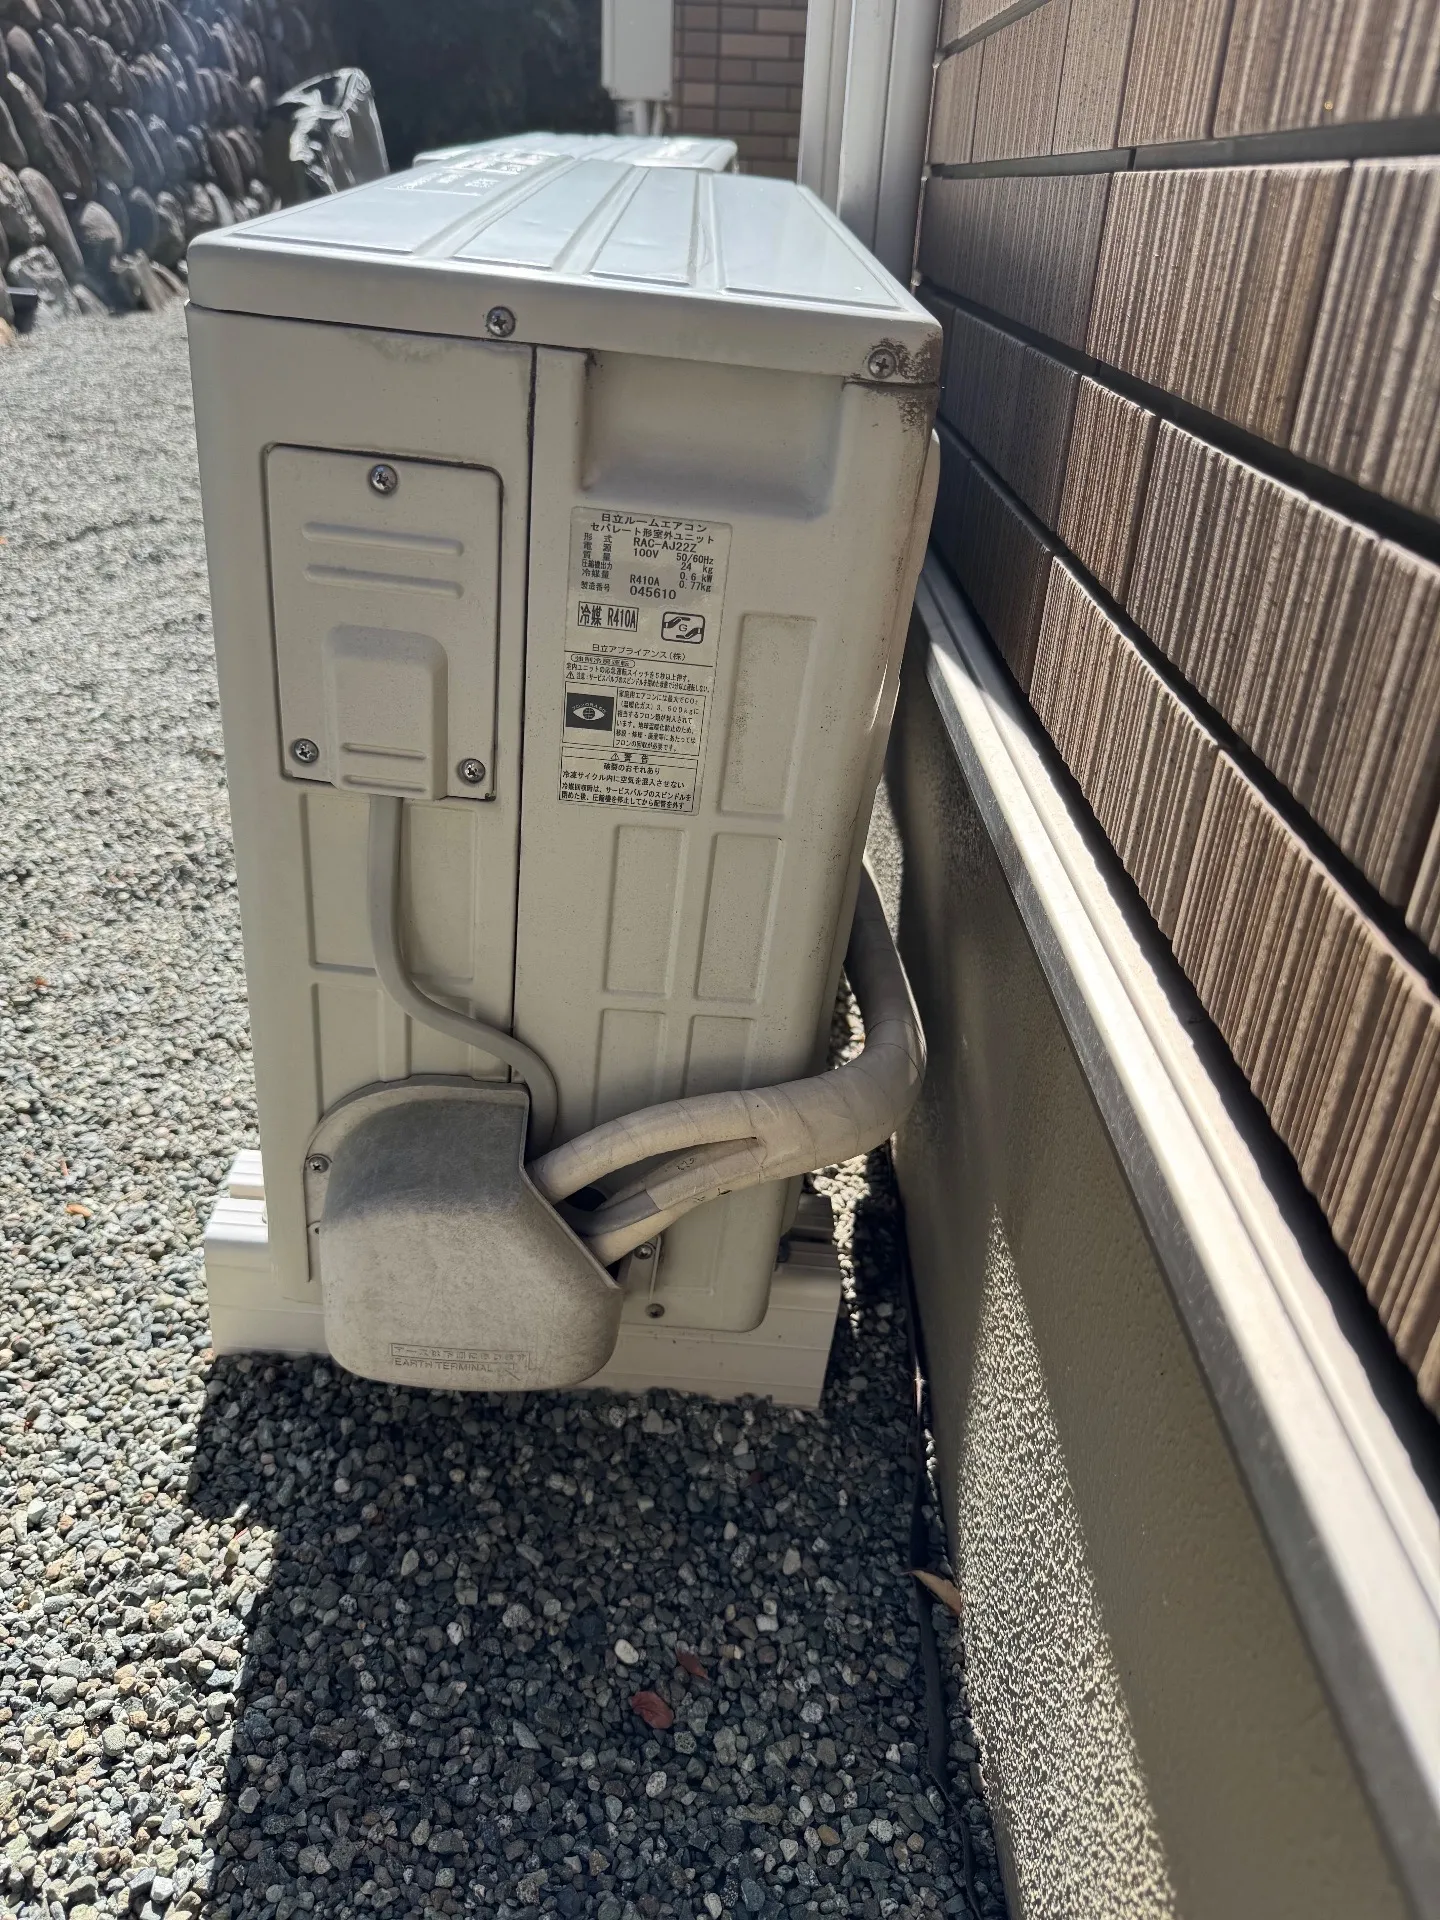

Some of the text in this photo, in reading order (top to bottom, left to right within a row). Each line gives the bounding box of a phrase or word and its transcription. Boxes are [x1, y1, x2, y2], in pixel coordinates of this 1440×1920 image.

[602, 513, 707, 532] 日立ルームエアコン
[634, 537, 697, 553] RAC-AJ22Z
[634, 548, 659, 559] 100V
[676, 553, 714, 565] 50/60Hz
[680, 562, 692, 571] 24
[702, 565, 713, 574] kg
[630, 574, 660, 586] R410A
[679, 581, 711, 592] 0.77kg
[701, 573, 713, 583] kW
[630, 586, 676, 600] 045610
[579, 604, 636, 629] 冷媒 R410A
[394, 1358, 495, 1372] EARTH TERMINAL
